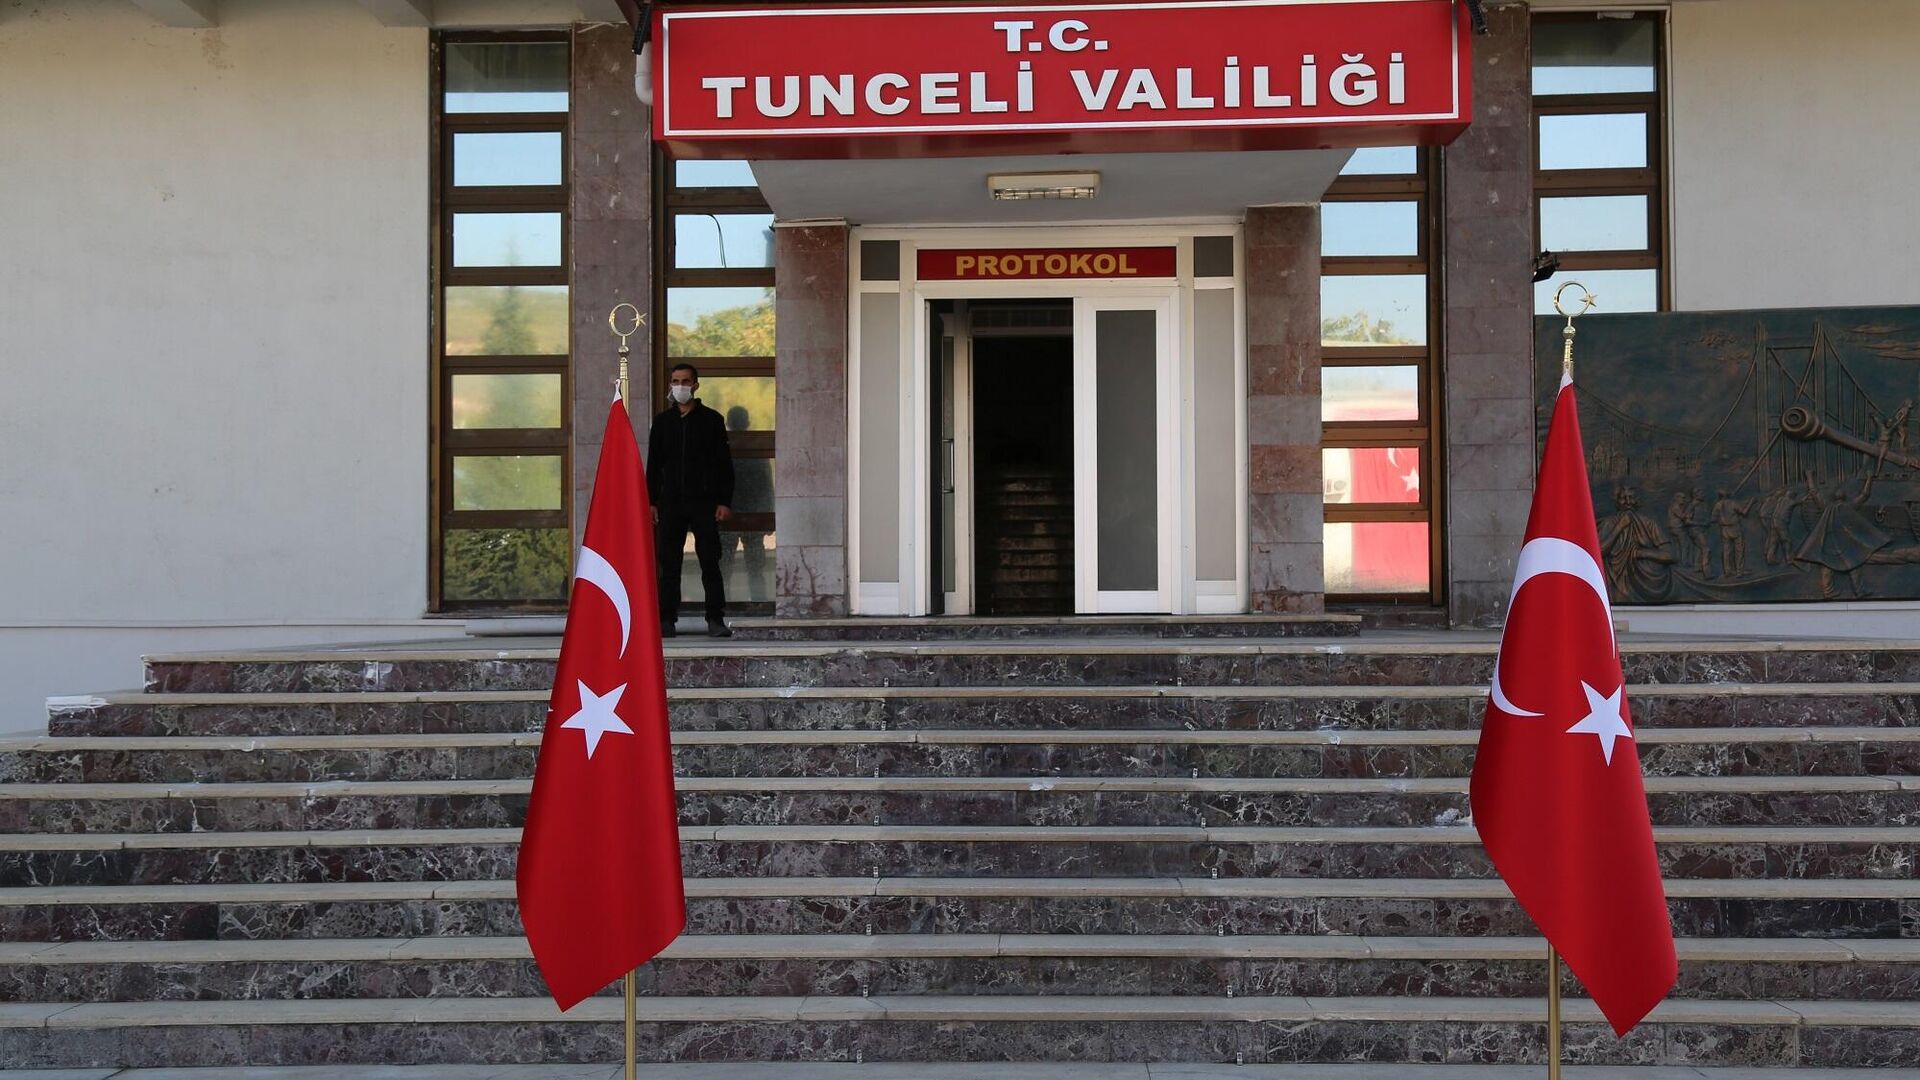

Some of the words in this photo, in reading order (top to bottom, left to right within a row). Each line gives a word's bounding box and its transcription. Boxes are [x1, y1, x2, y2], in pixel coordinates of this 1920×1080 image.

[993, 19, 1109, 51] T.C.
[701, 60, 1034, 119] TUNCELİ
[1070, 51, 1406, 111] VALİLİĞİ
[955, 253, 1137, 276] PROTOKOL
